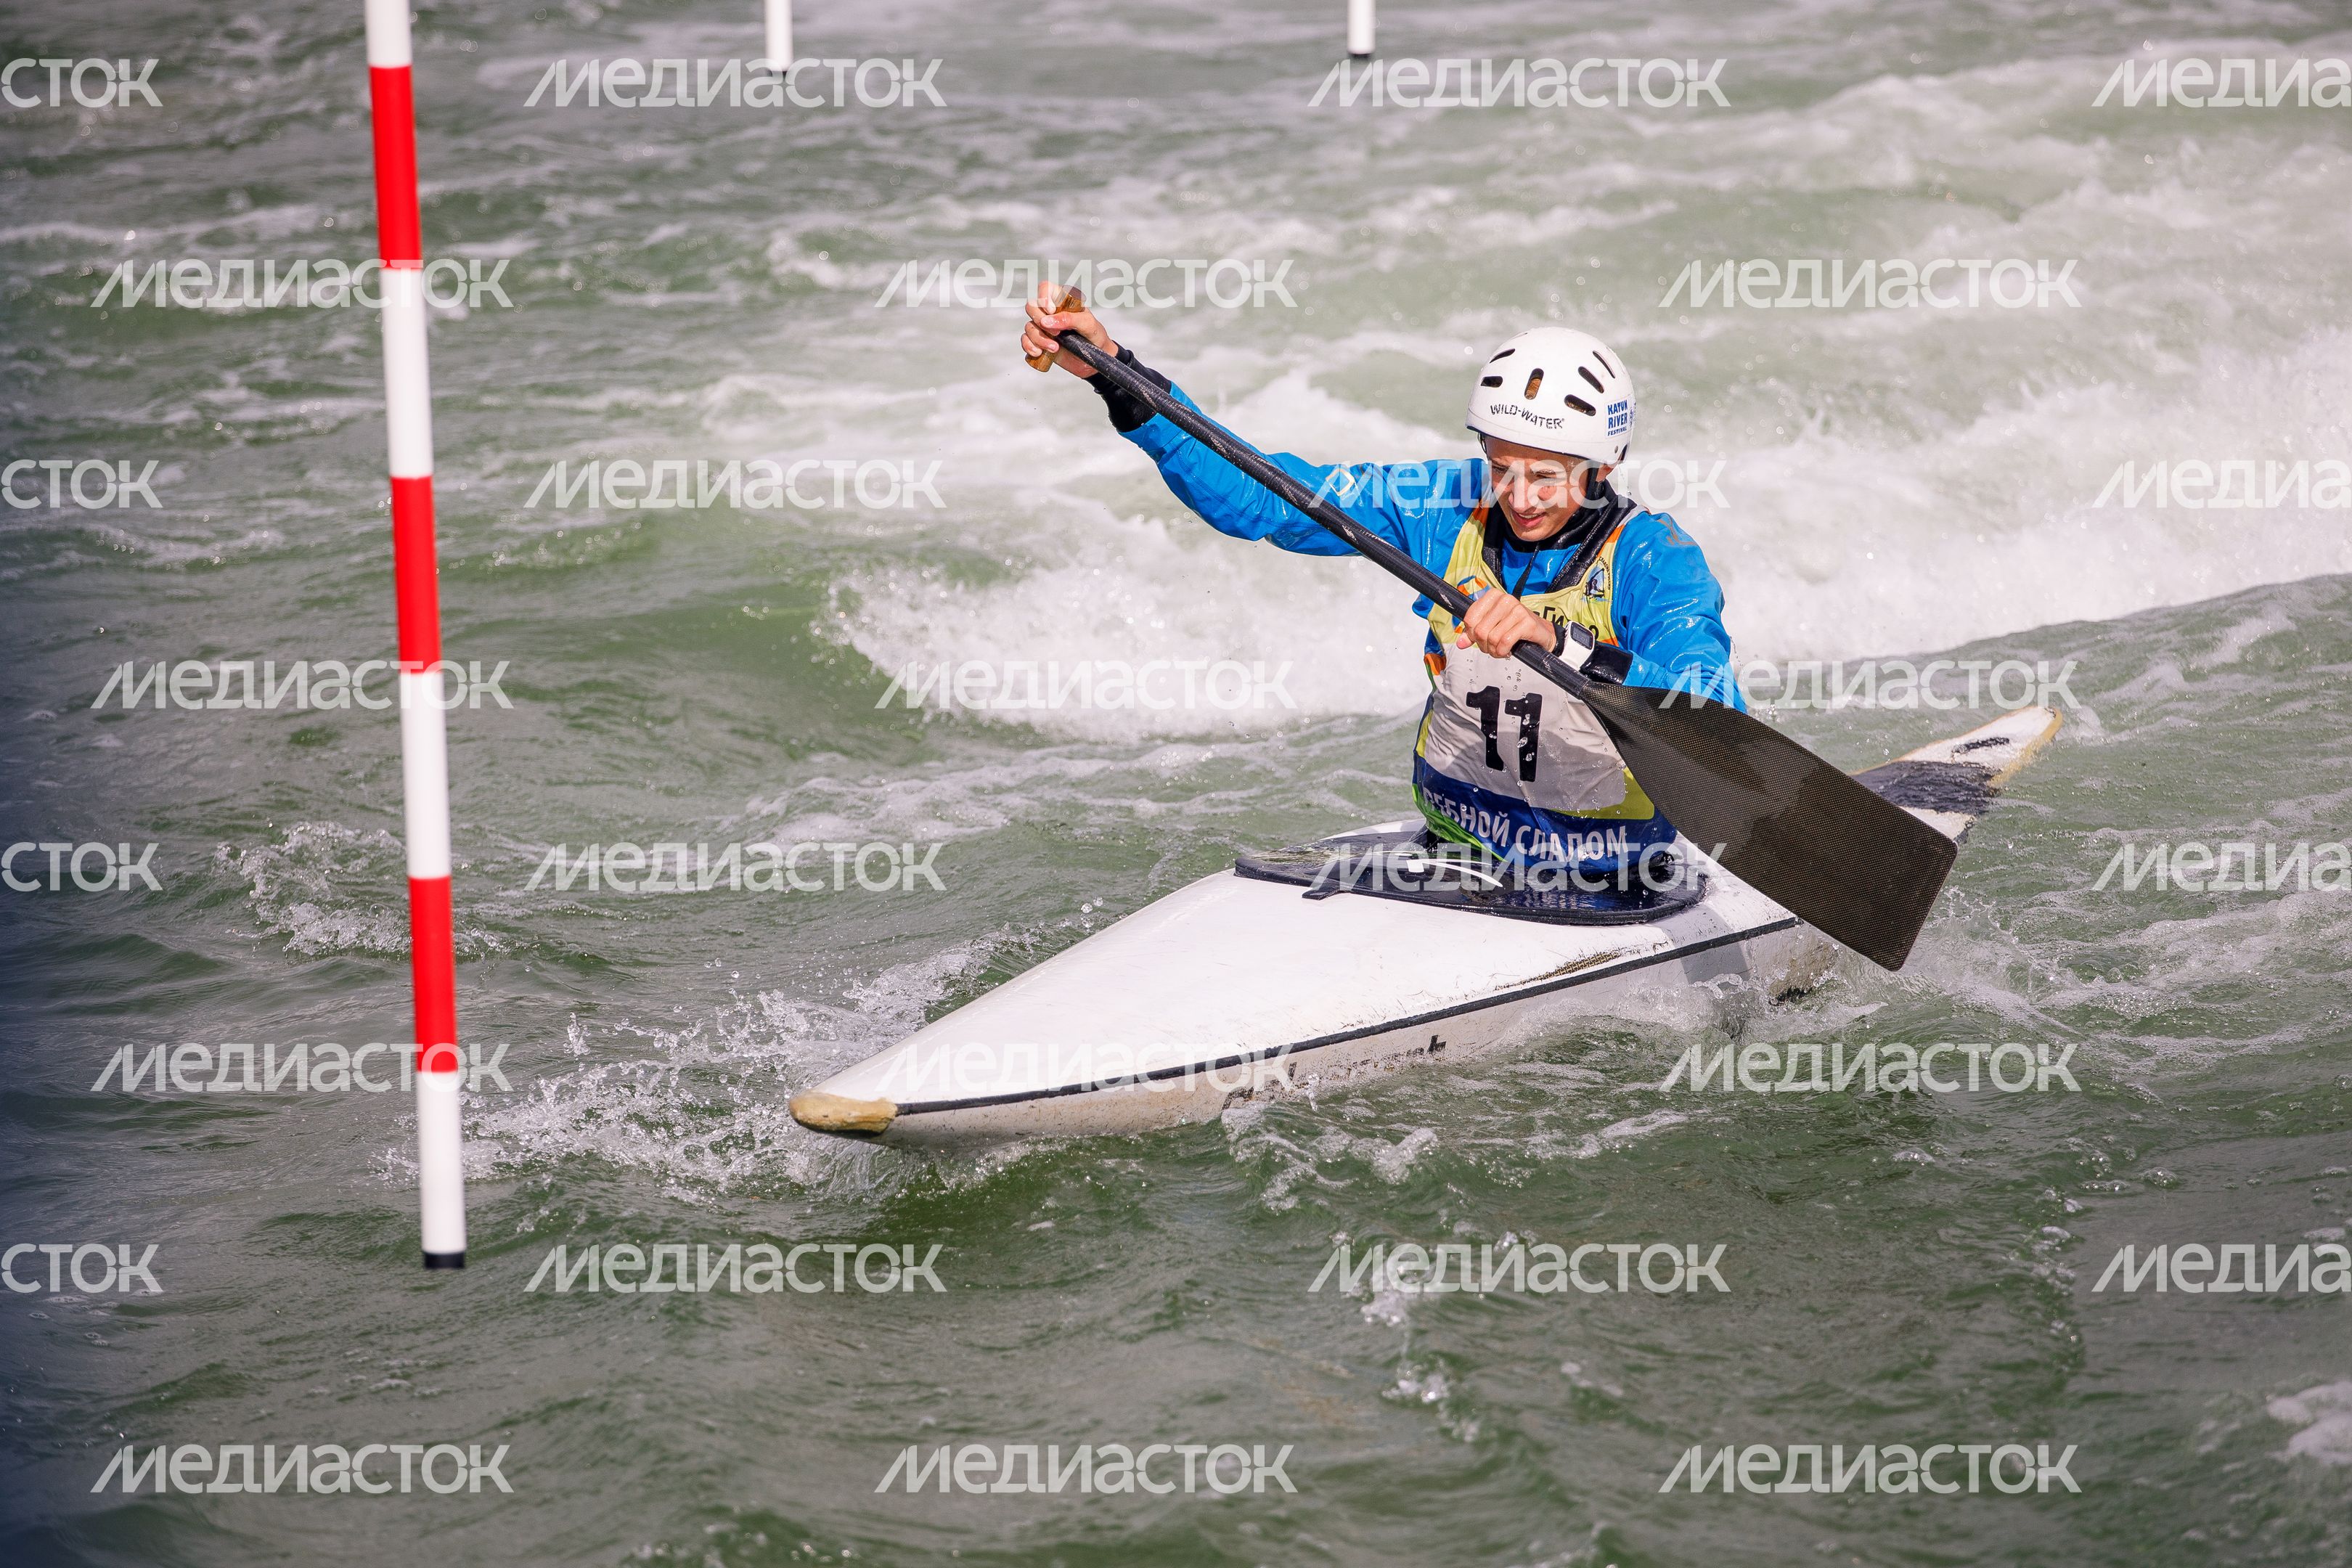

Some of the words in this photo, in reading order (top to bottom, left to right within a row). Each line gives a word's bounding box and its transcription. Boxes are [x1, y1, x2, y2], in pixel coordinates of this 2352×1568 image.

[1490, 404, 1563, 429] WILD-WATER
[1607, 399, 1628, 415] KATUN
[1607, 425, 1628, 436] FESTIVAL
[1608, 412, 1628, 429] RIVER
[1466, 685, 1543, 783] 11
[1515, 825, 1629, 862] СЛАЛОМ
